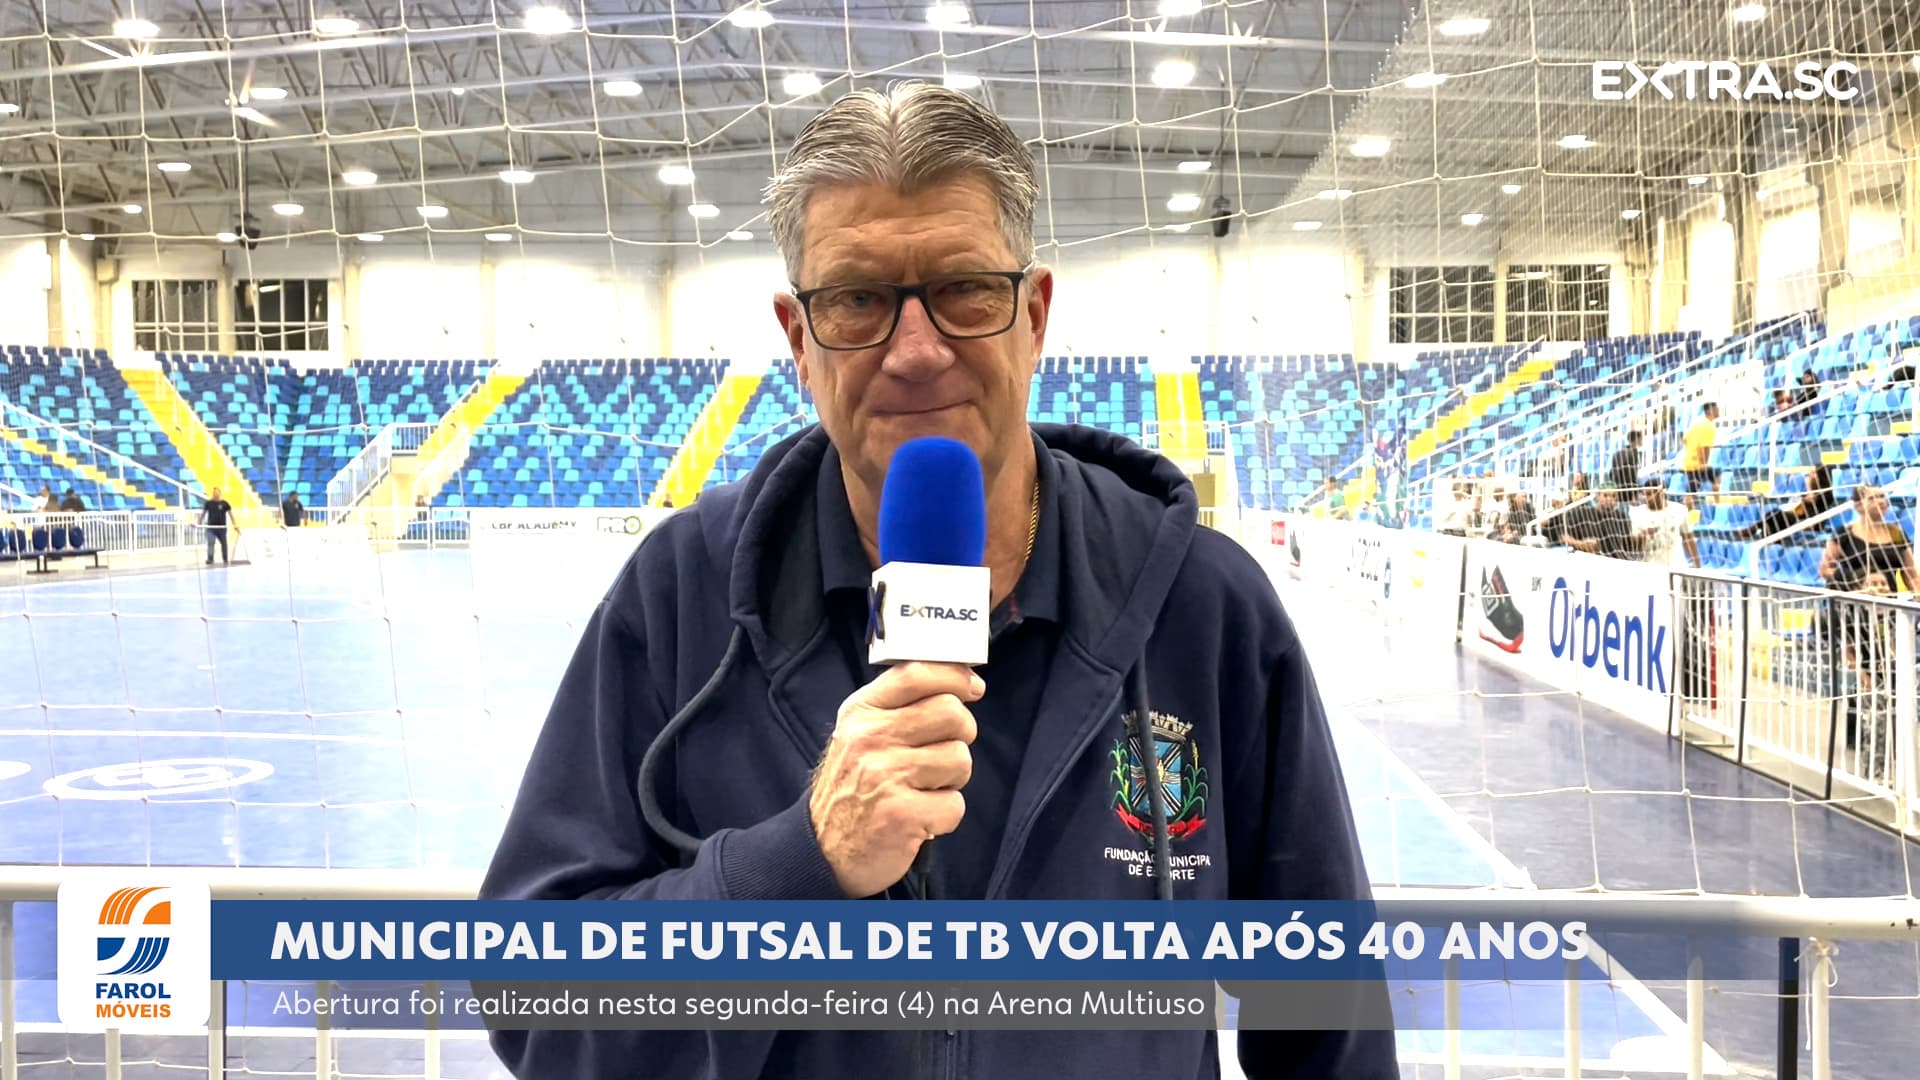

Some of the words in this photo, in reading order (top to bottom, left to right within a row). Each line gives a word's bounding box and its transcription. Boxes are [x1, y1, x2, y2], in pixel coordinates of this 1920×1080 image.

[900, 604, 978, 622] EXTRA.SC
[1549, 576, 1666, 694] Orbenk
[1166, 854, 1211, 868] UNICIPA
[1128, 864, 1143, 876] DE
